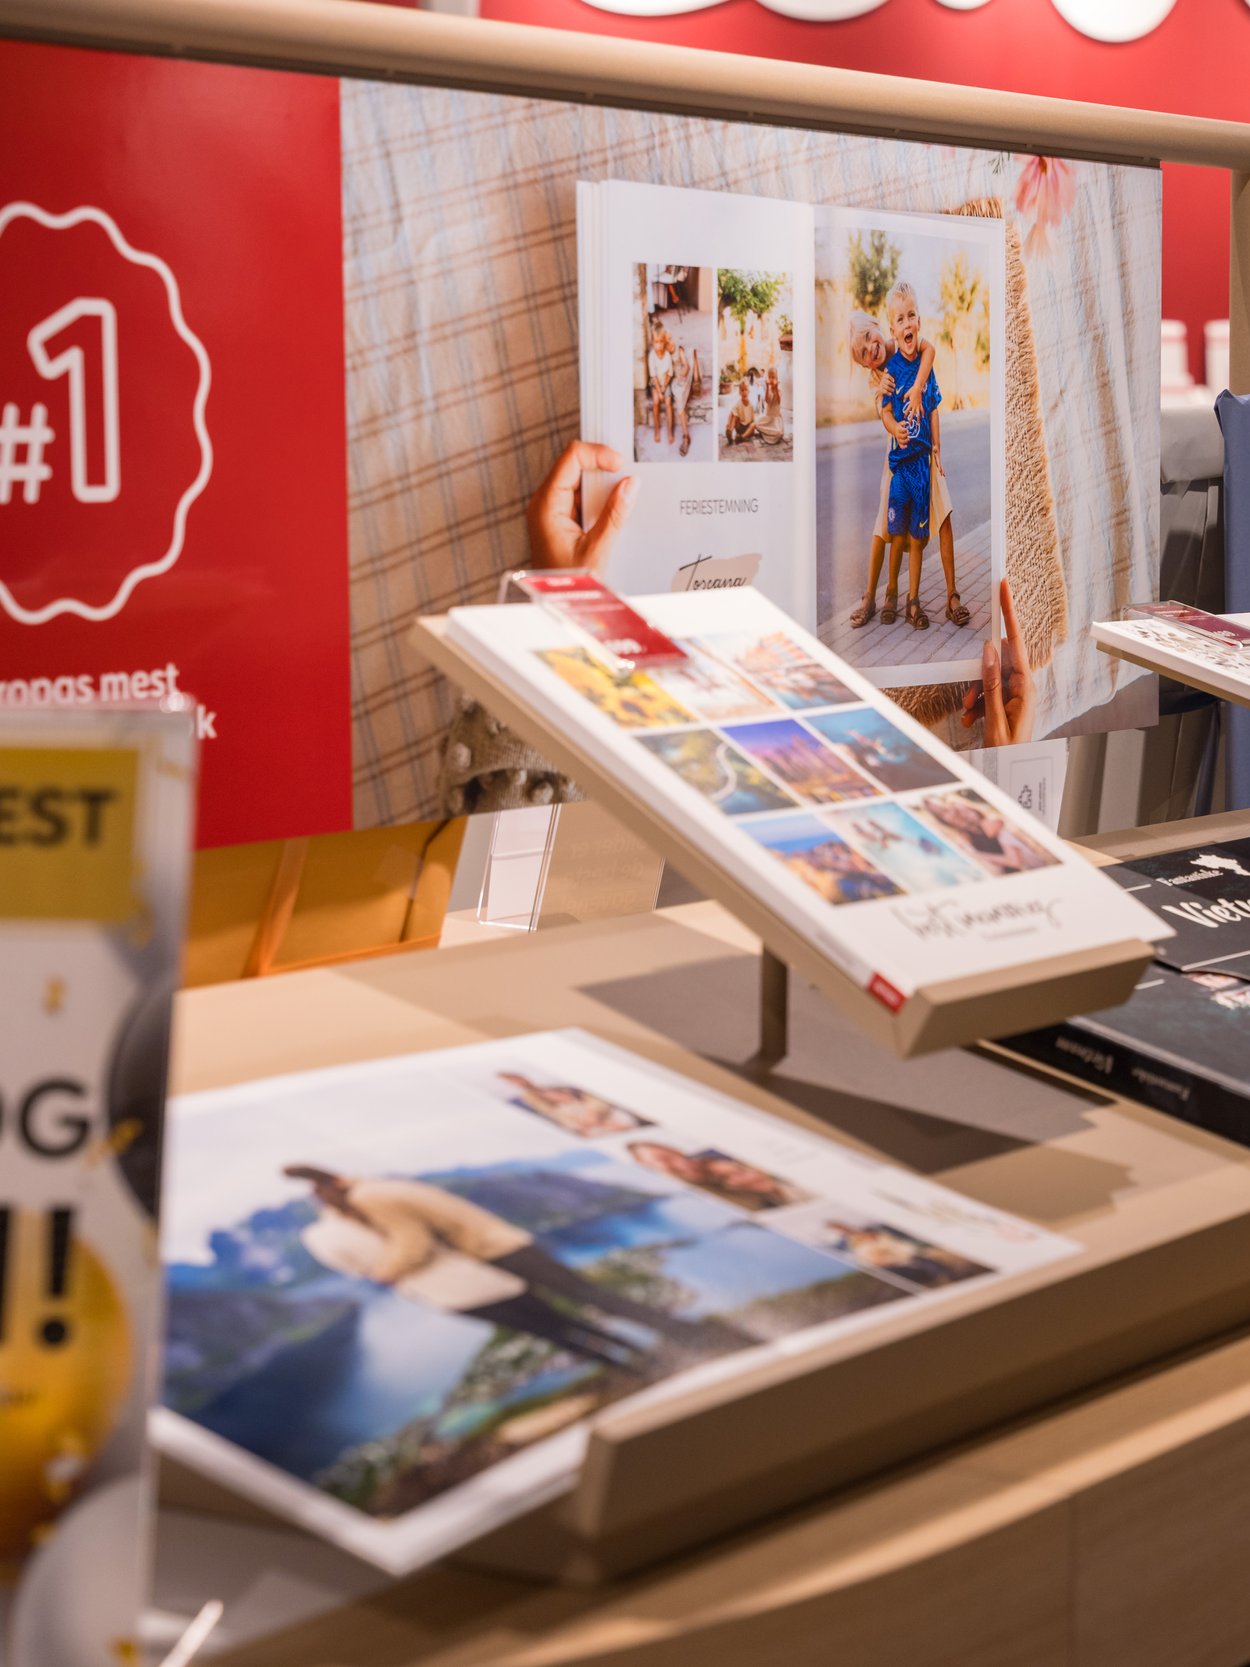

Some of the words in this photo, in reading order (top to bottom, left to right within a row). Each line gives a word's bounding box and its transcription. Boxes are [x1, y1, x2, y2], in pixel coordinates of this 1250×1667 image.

[0, 297, 121, 504] #1
[679, 498, 760, 516] FERIESTEMNING
[678, 553, 748, 592] Toscana
[100, 662, 180, 701] mest
